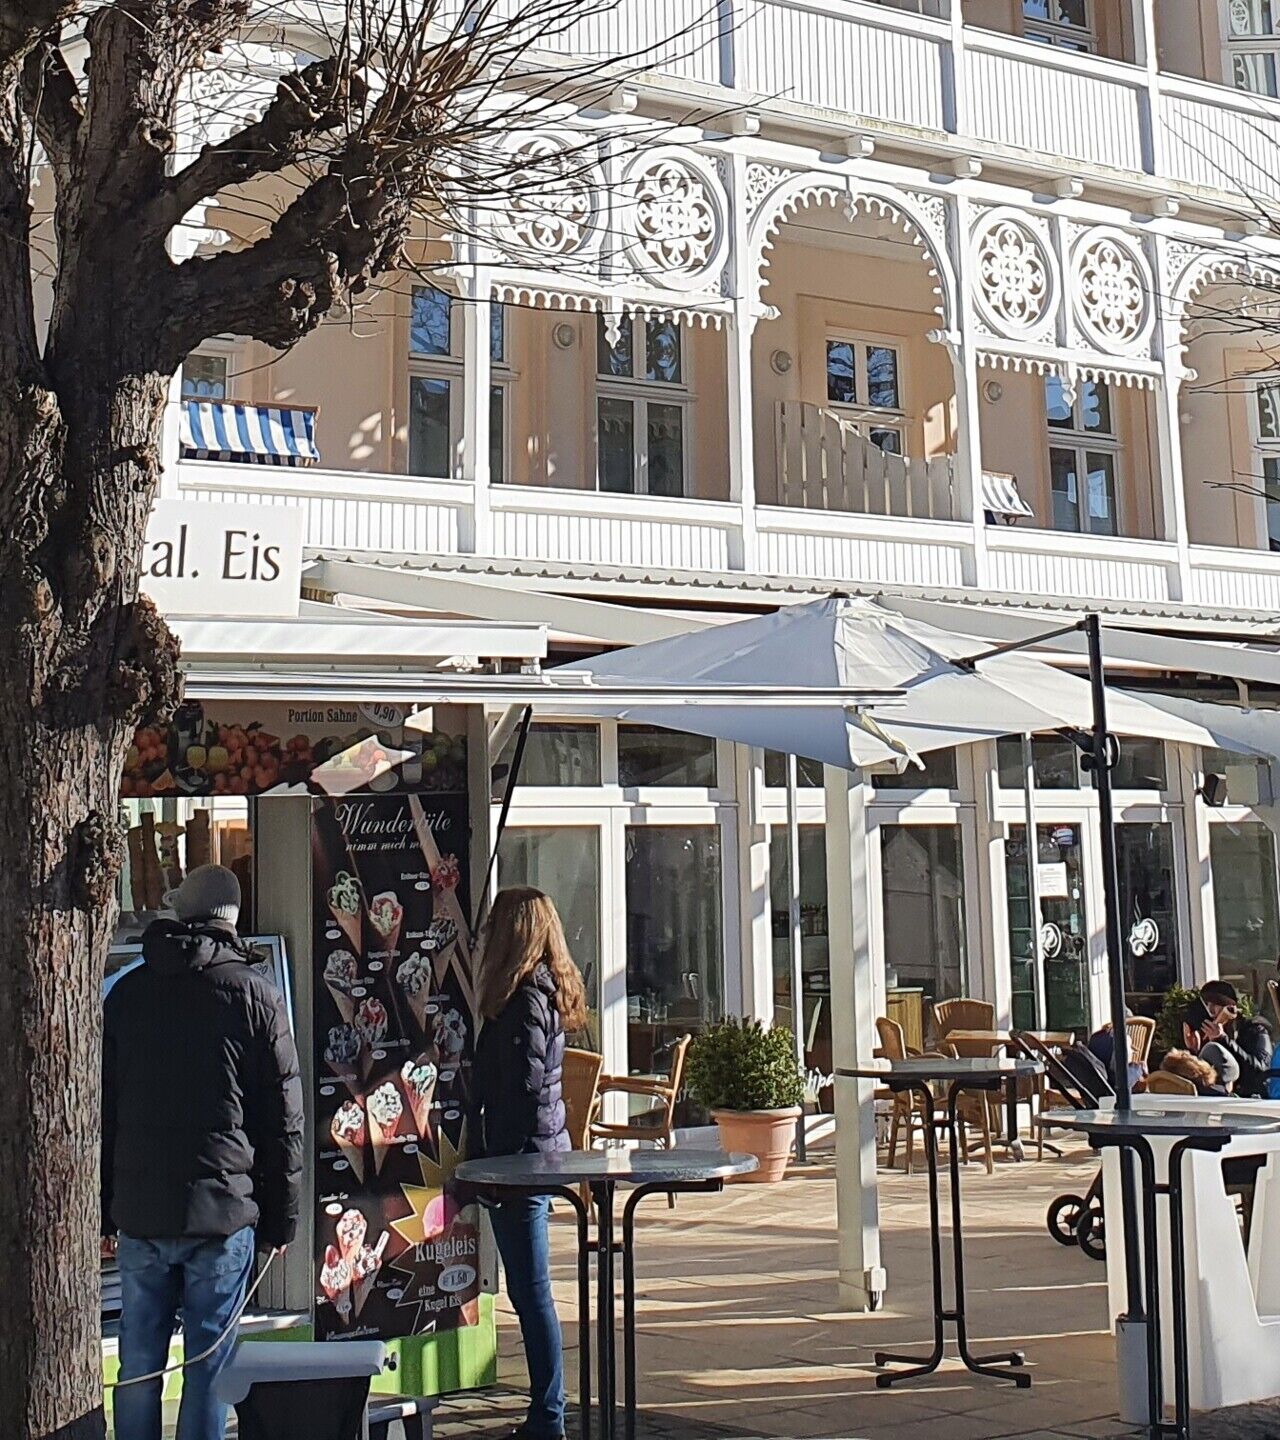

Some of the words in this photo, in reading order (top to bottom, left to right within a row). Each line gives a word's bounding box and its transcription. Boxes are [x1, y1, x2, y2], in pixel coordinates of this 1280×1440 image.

[222, 530, 280, 581] Eis
[288, 708, 325, 723] Portion
[326, 708, 358, 723] Sahne
[414, 1234, 476, 1264] Kugeleis
